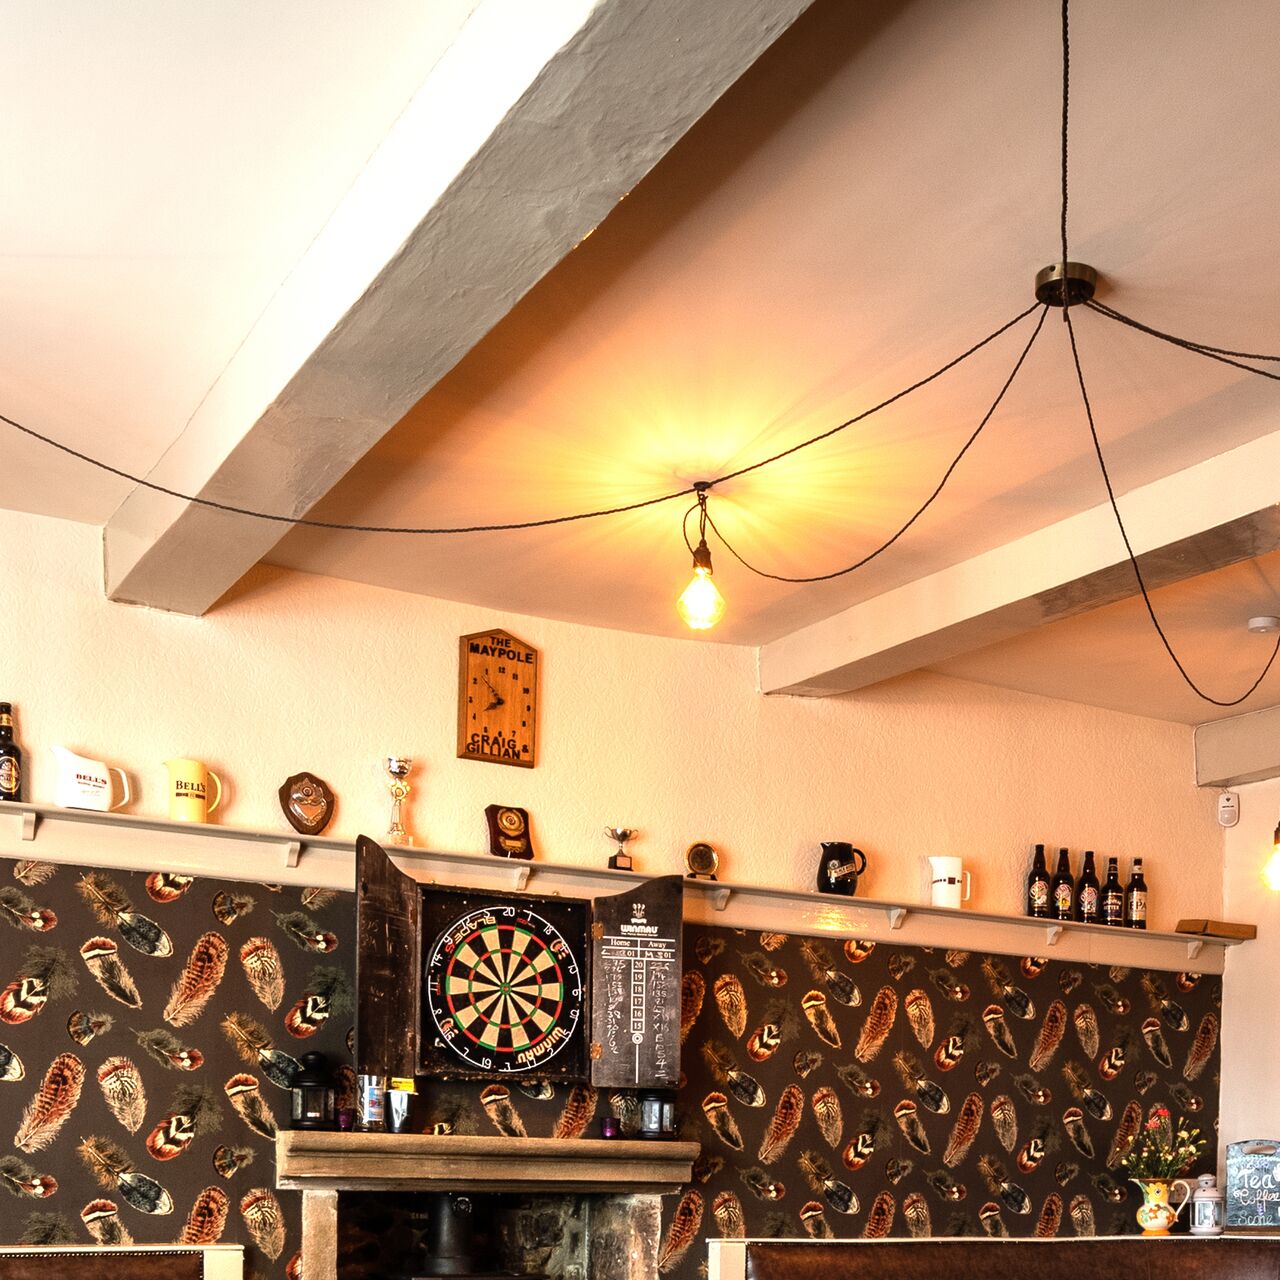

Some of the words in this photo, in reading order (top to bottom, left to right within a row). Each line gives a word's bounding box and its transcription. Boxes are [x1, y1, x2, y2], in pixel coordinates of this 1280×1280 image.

[490, 636, 511, 648] THE
[469, 642, 534, 664] MAYPOLE
[498, 666, 506, 674] 12
[466, 742, 521, 760] GILLIAN
[471, 733, 517, 750] CRAIG
[521, 744, 529, 754] &
[503, 907, 515, 917] 20
[620, 924, 658, 934] WINMAU
[648, 942, 667, 950] Away
[517, 1026, 565, 1064] WINMAU
[1236, 1167, 1276, 1188] Tea
